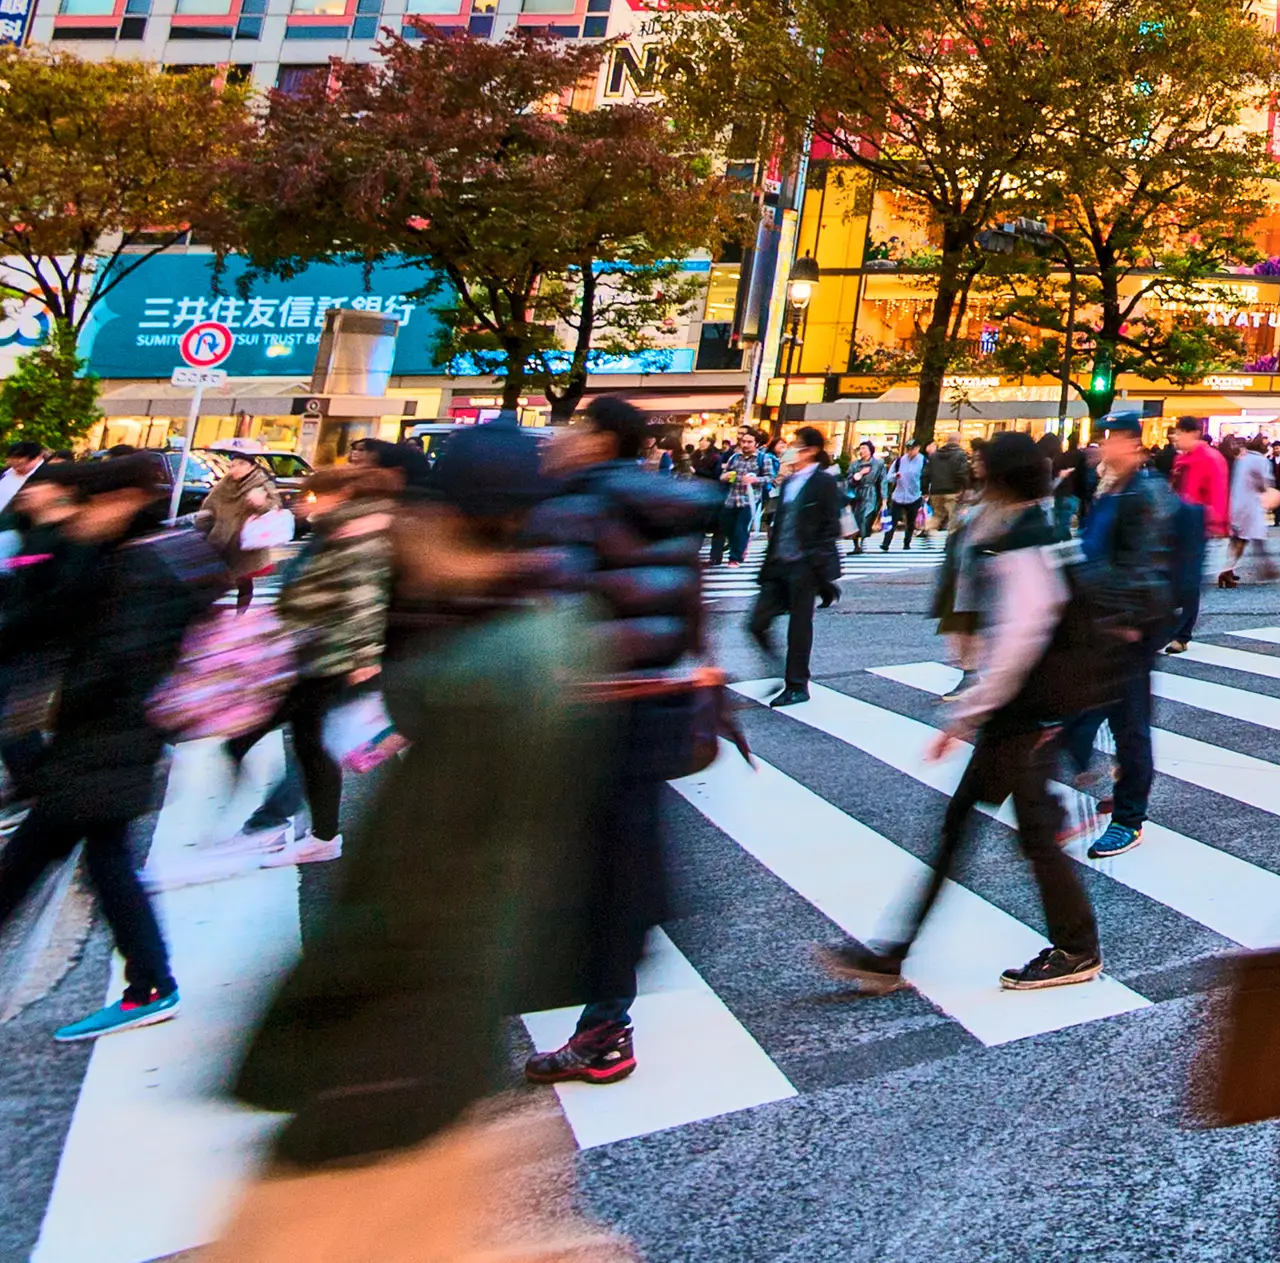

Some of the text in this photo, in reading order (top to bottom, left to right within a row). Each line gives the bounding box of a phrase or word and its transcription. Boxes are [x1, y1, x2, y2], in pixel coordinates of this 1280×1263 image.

[136, 332, 323, 347] SUMIT TSUI TRUST BA
